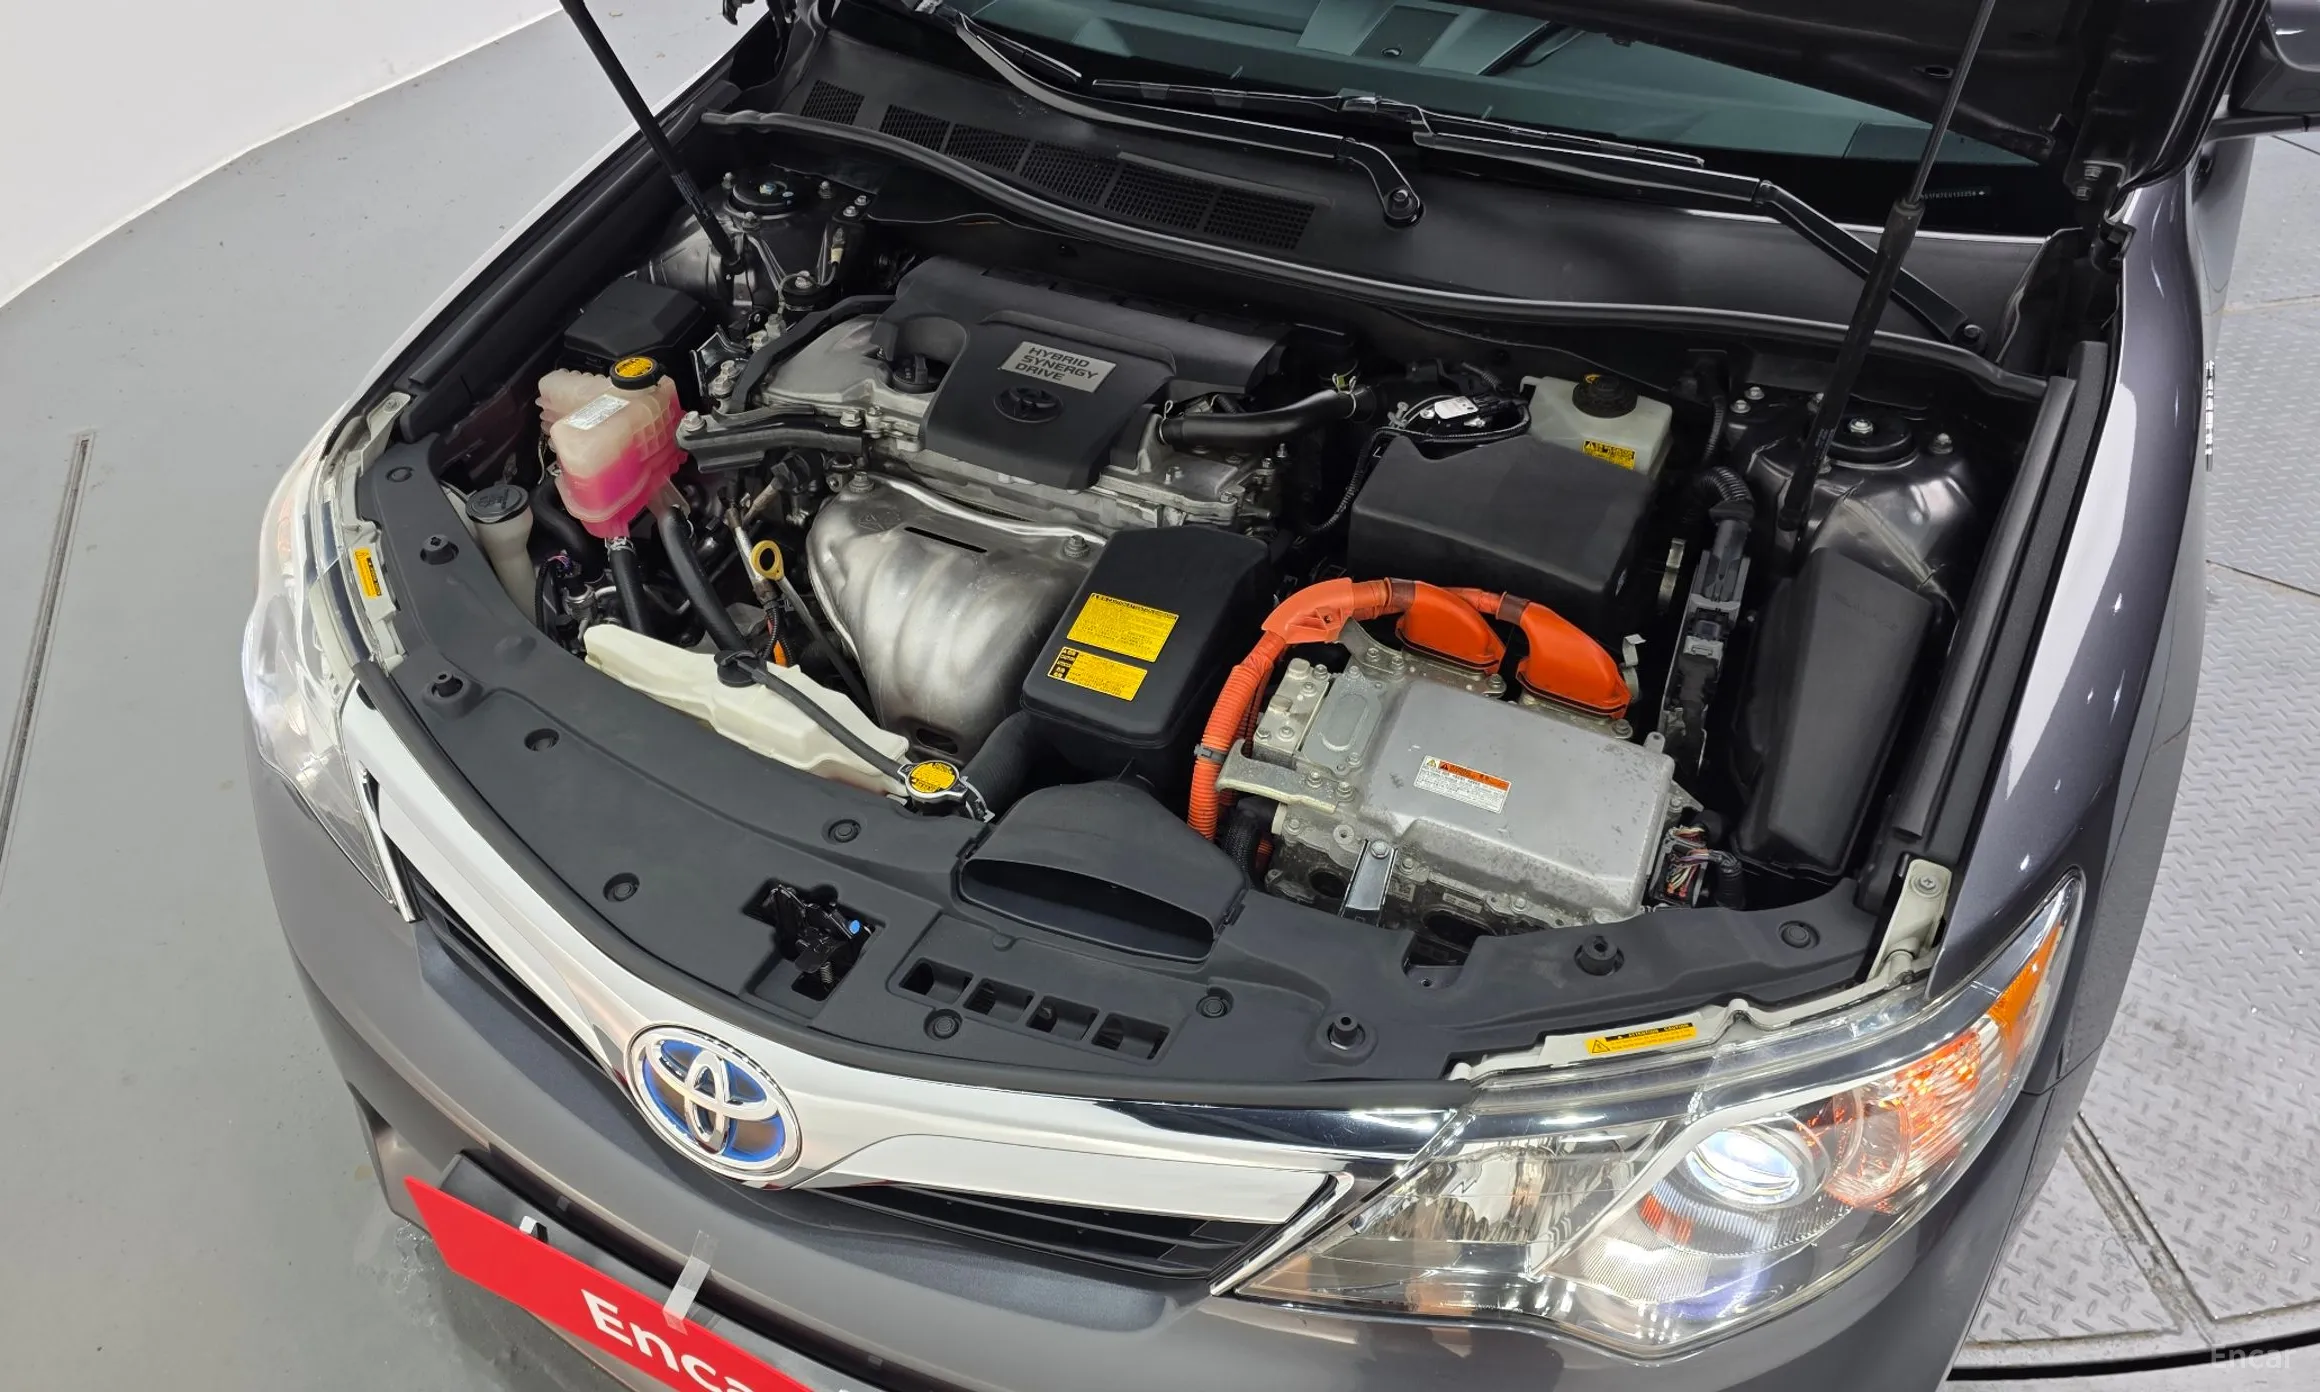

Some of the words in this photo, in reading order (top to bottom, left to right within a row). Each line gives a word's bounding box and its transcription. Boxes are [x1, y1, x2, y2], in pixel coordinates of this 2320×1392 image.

[1021, 355, 1099, 379] SYNERGY
[1028, 347, 1090, 368] HYBRID
[1015, 363, 1066, 381] DRIVE
